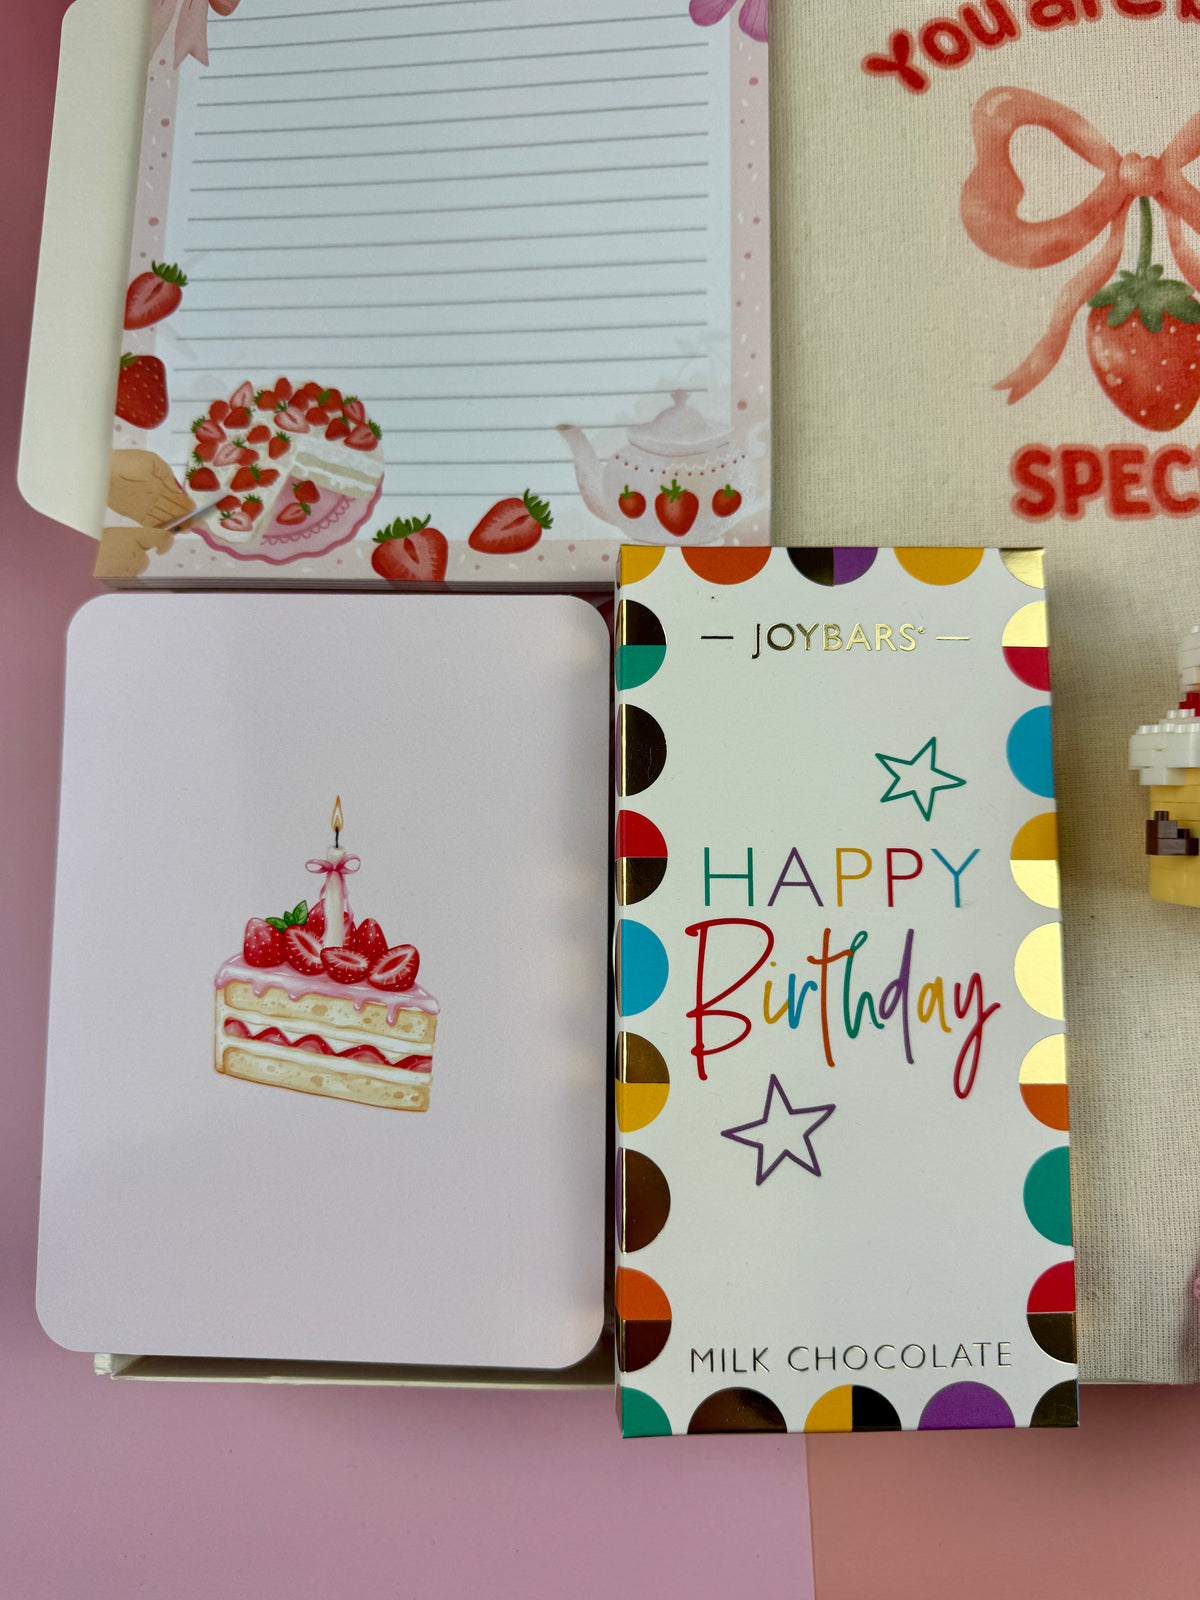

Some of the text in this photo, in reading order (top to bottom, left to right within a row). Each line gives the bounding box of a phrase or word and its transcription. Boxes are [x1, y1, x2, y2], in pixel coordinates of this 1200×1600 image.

[861, 0, 1021, 95] You
[703, 846, 981, 908] HAPPY
[685, 917, 1001, 1100] Birthday
[690, 1341, 1013, 1373] MILK CHOCOLATE
